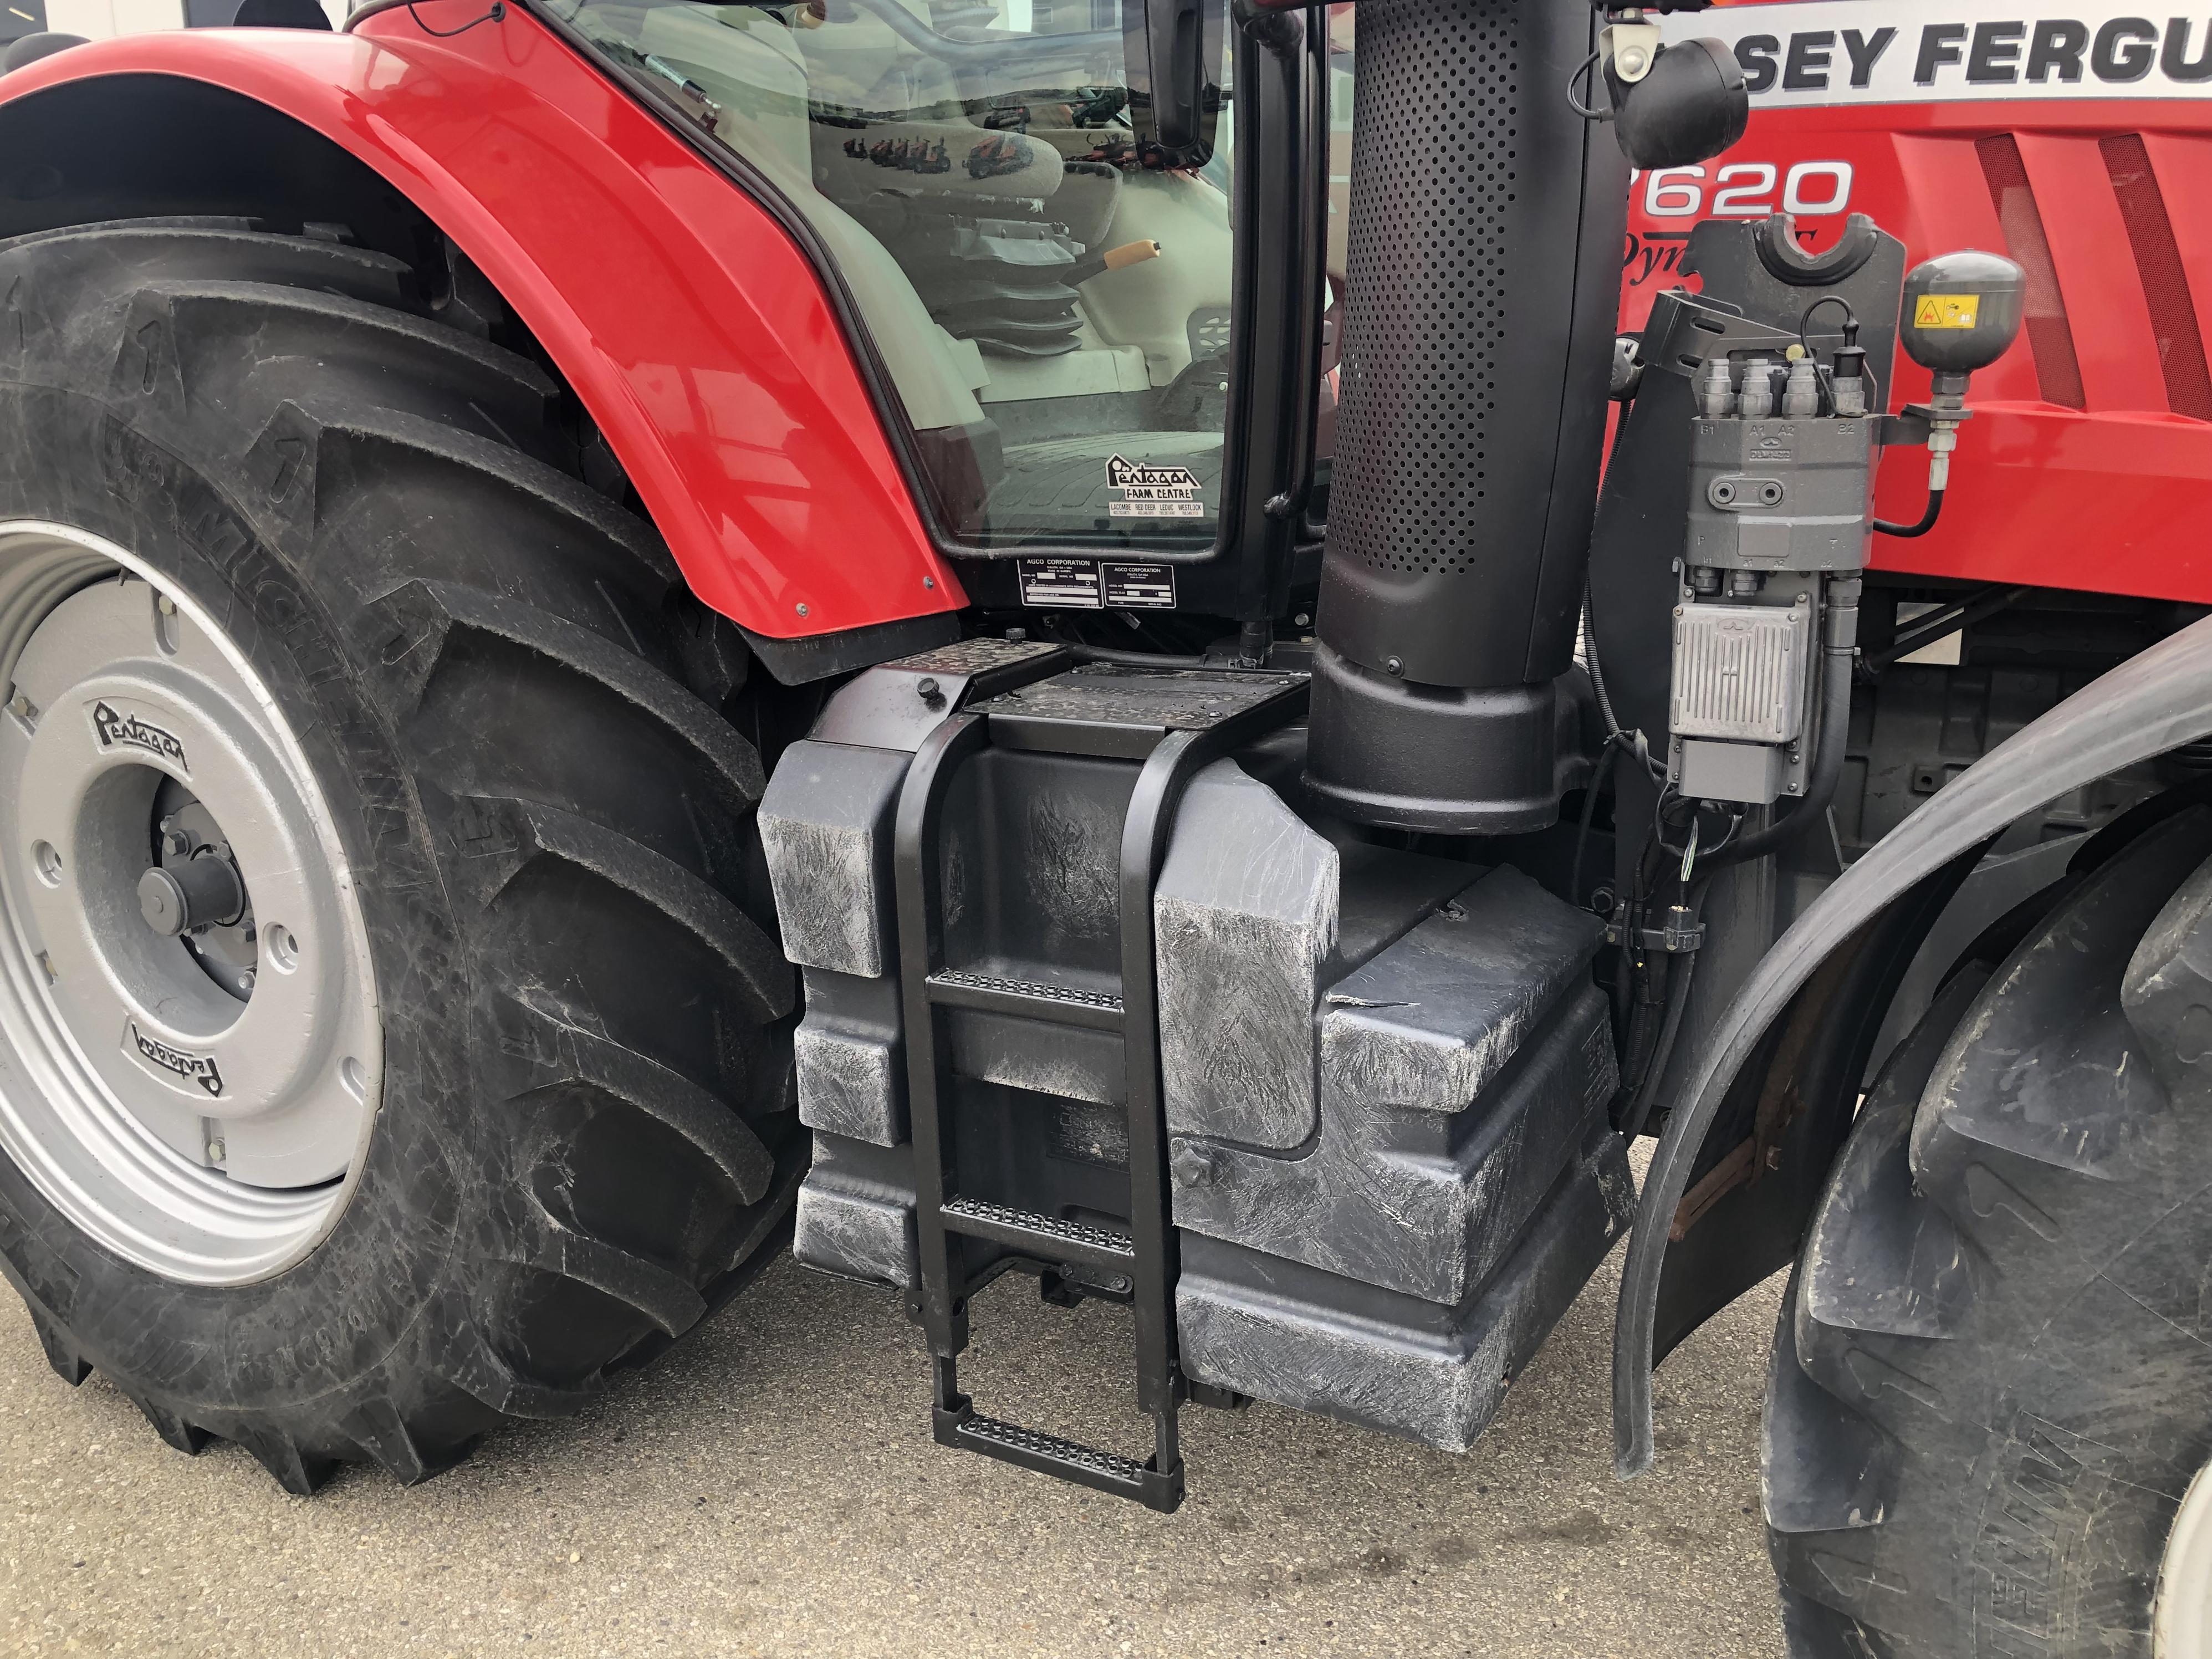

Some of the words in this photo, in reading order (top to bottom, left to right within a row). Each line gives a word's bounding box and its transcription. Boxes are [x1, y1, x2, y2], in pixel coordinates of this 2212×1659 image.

[1914, 17, 2212, 89] FERGU
[1631, 160, 1853, 217] 620
[1127, 489, 1153, 498] FARM
